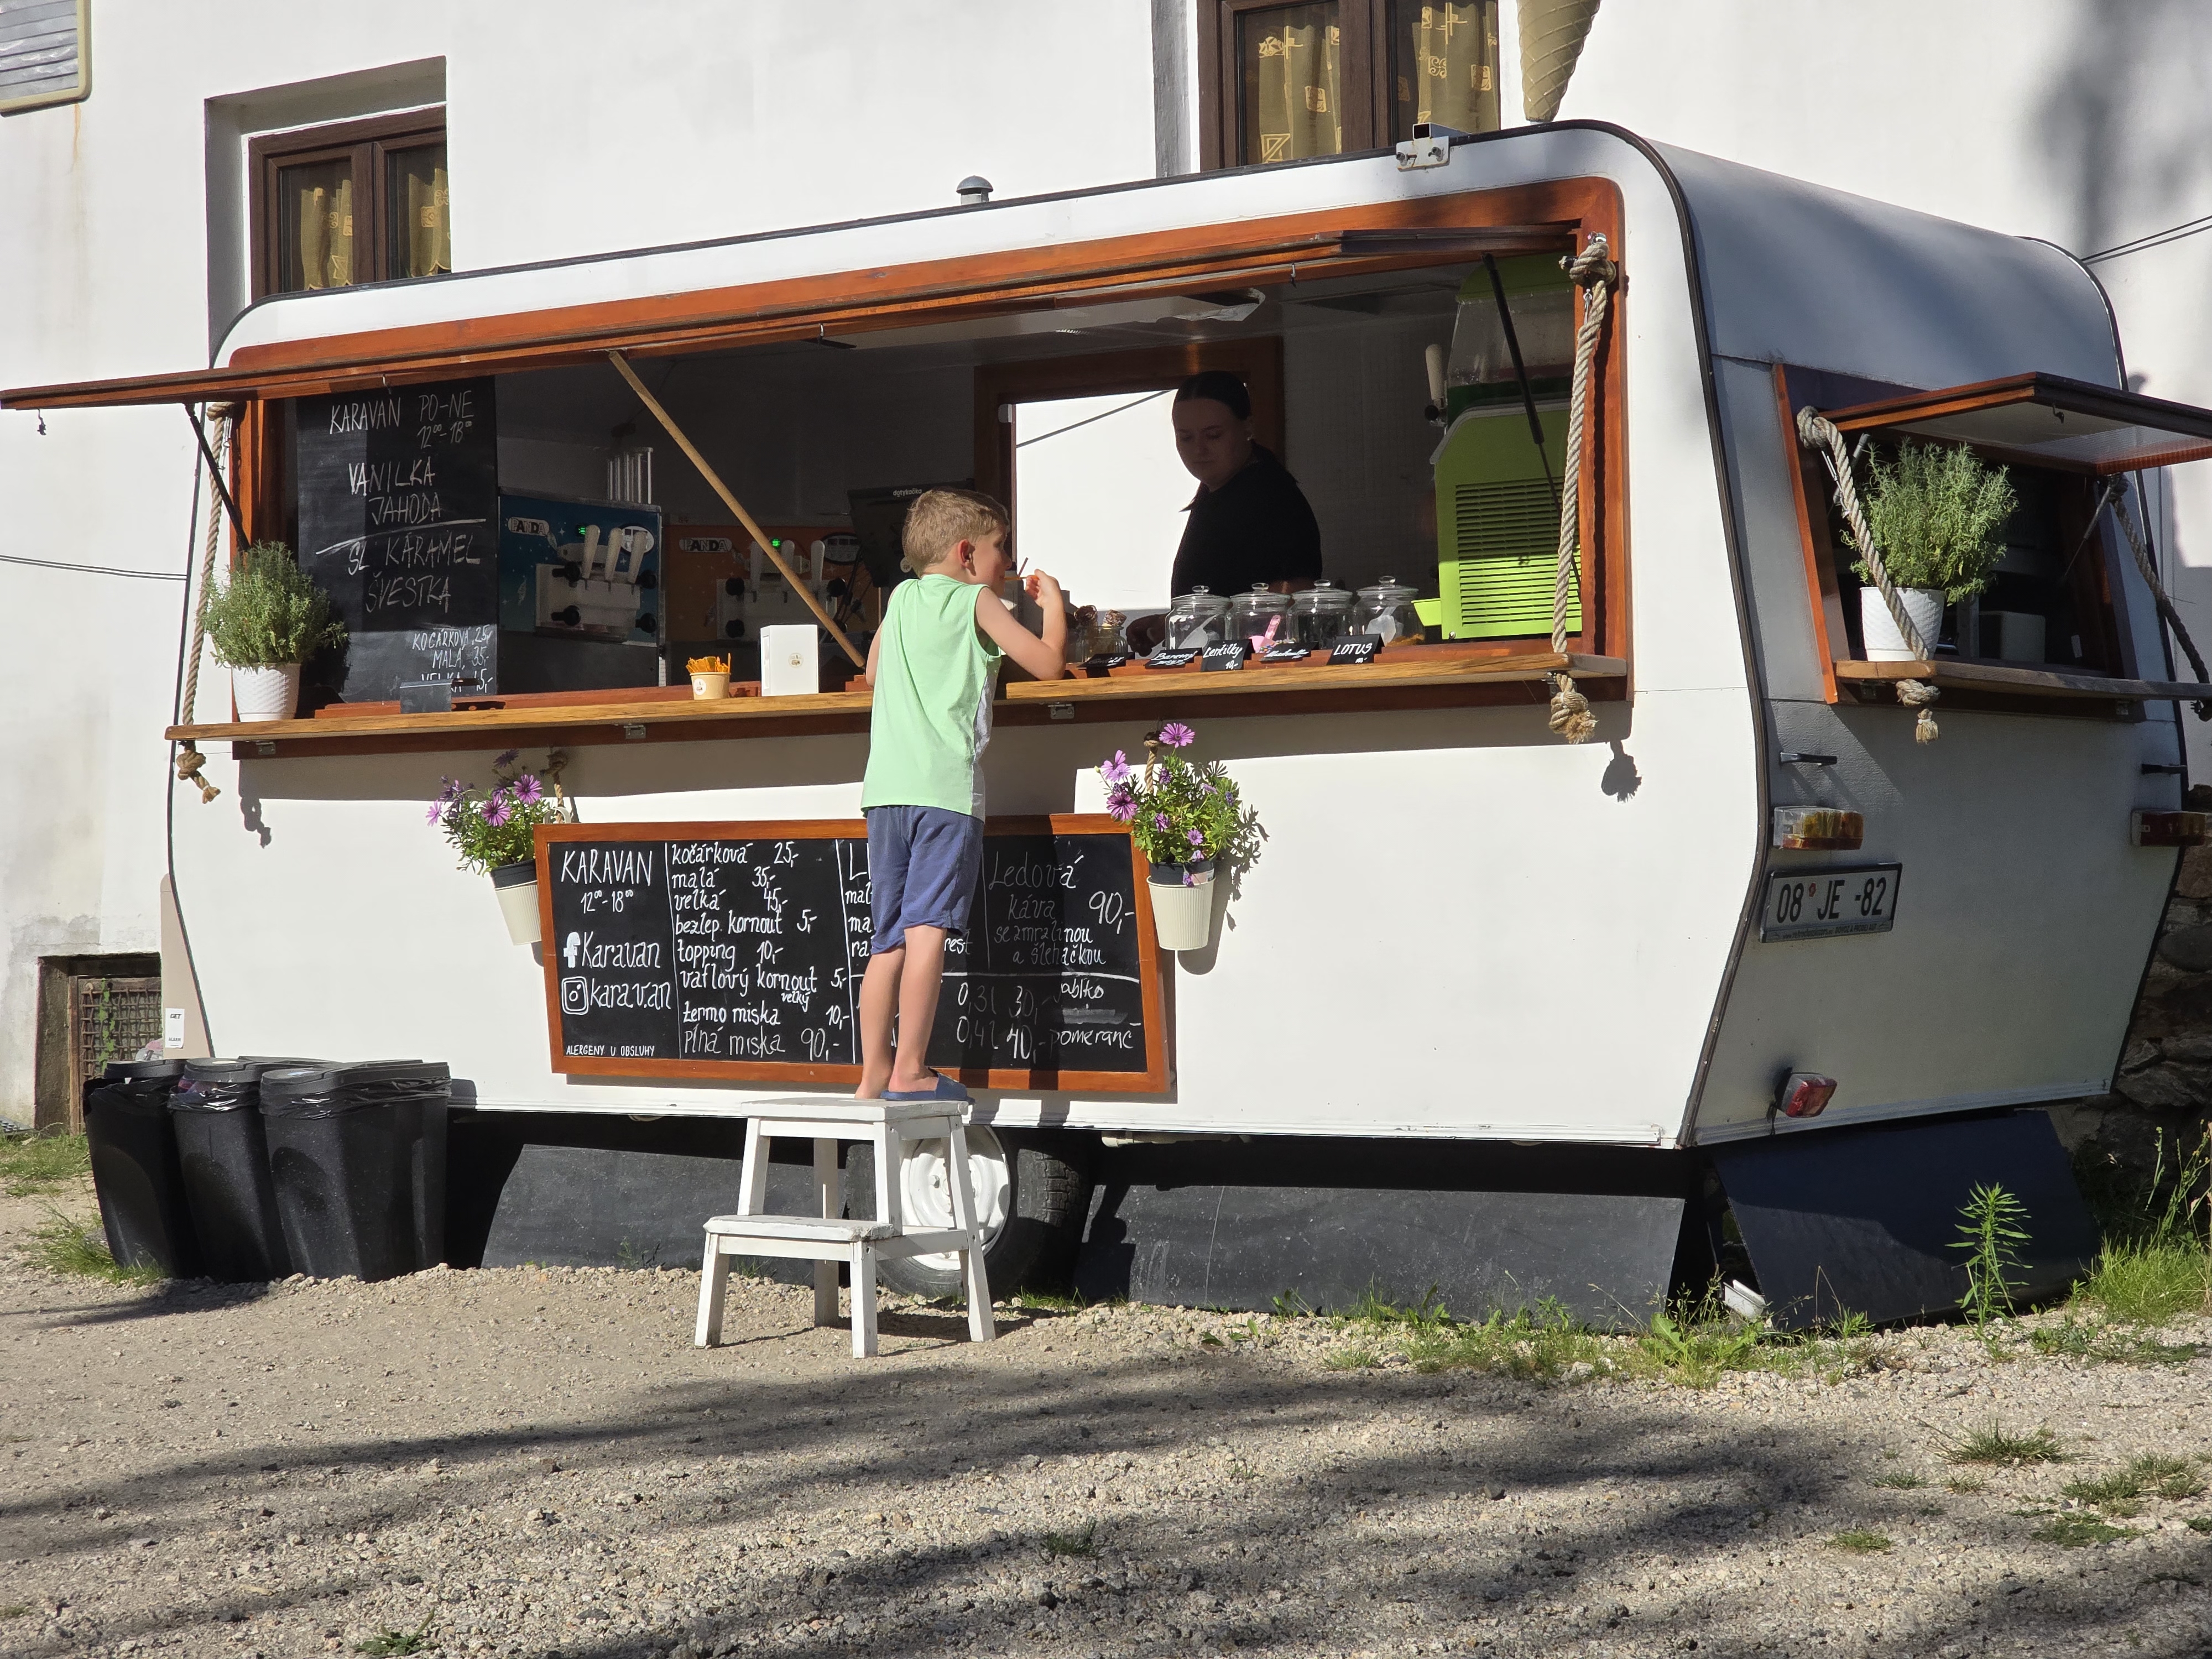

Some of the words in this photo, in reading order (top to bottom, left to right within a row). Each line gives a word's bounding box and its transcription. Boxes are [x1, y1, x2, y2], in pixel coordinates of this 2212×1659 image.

[330, 397, 401, 434] KARAVAN
[348, 456, 435, 497] VANILKA
[369, 492, 441, 525] JAHODA
[511, 518, 546, 536] PANDA
[385, 531, 481, 568] KARAMEL
[682, 538, 729, 552] PANDA
[366, 571, 451, 613] ŠVESTKA
[1203, 641, 1243, 659] Lentilky
[1333, 643, 1373, 656] LOTUS
[671, 841, 753, 865] kočárková
[561, 849, 653, 886] KARAVAN
[671, 866, 719, 889] malá
[988, 851, 1084, 890] Ledová
[674, 889, 726, 911] velká
[1776, 883, 1804, 923] 08
[1817, 879, 1845, 920] JE
[728, 910, 783, 934] kornout
[677, 939, 735, 972] topping
[1013, 951, 1025, 964] a
[680, 963, 748, 997] vaflový
[755, 963, 818, 993] kornout
[683, 1000, 727, 1023] termo
[732, 1000, 781, 1025] miska
[781, 990, 811, 1013] velký
[566, 1044, 604, 1056] ALERGENY
[620, 1046, 655, 1057] OBSLUHY
[729, 1025, 785, 1058] miska
